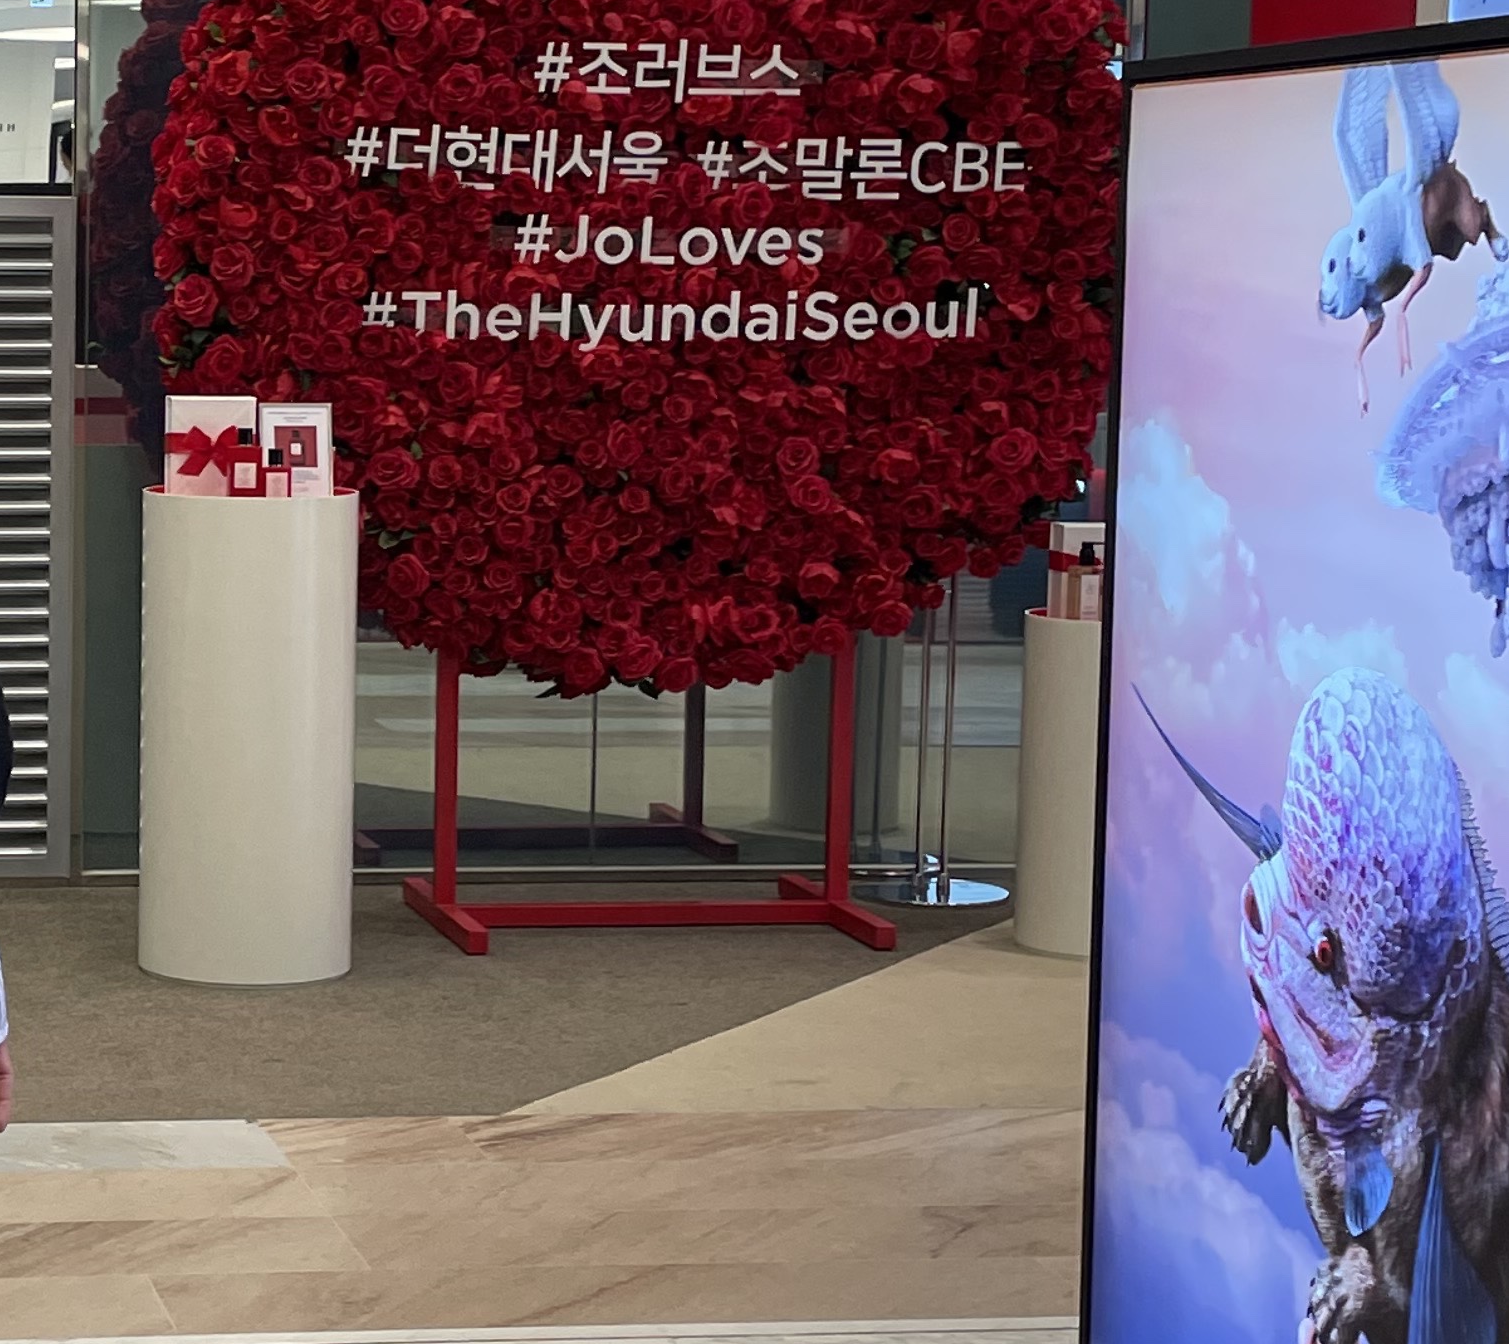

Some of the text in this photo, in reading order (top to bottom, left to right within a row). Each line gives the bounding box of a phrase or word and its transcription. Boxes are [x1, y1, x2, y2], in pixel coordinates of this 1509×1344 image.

[533, 38, 801, 104] #조러브스
[344, 123, 1027, 201] #더현대서울 #조말론CBE
[514, 214, 825, 267] #JoLoves
[361, 288, 980, 353] #TheHyundaiSeoul
